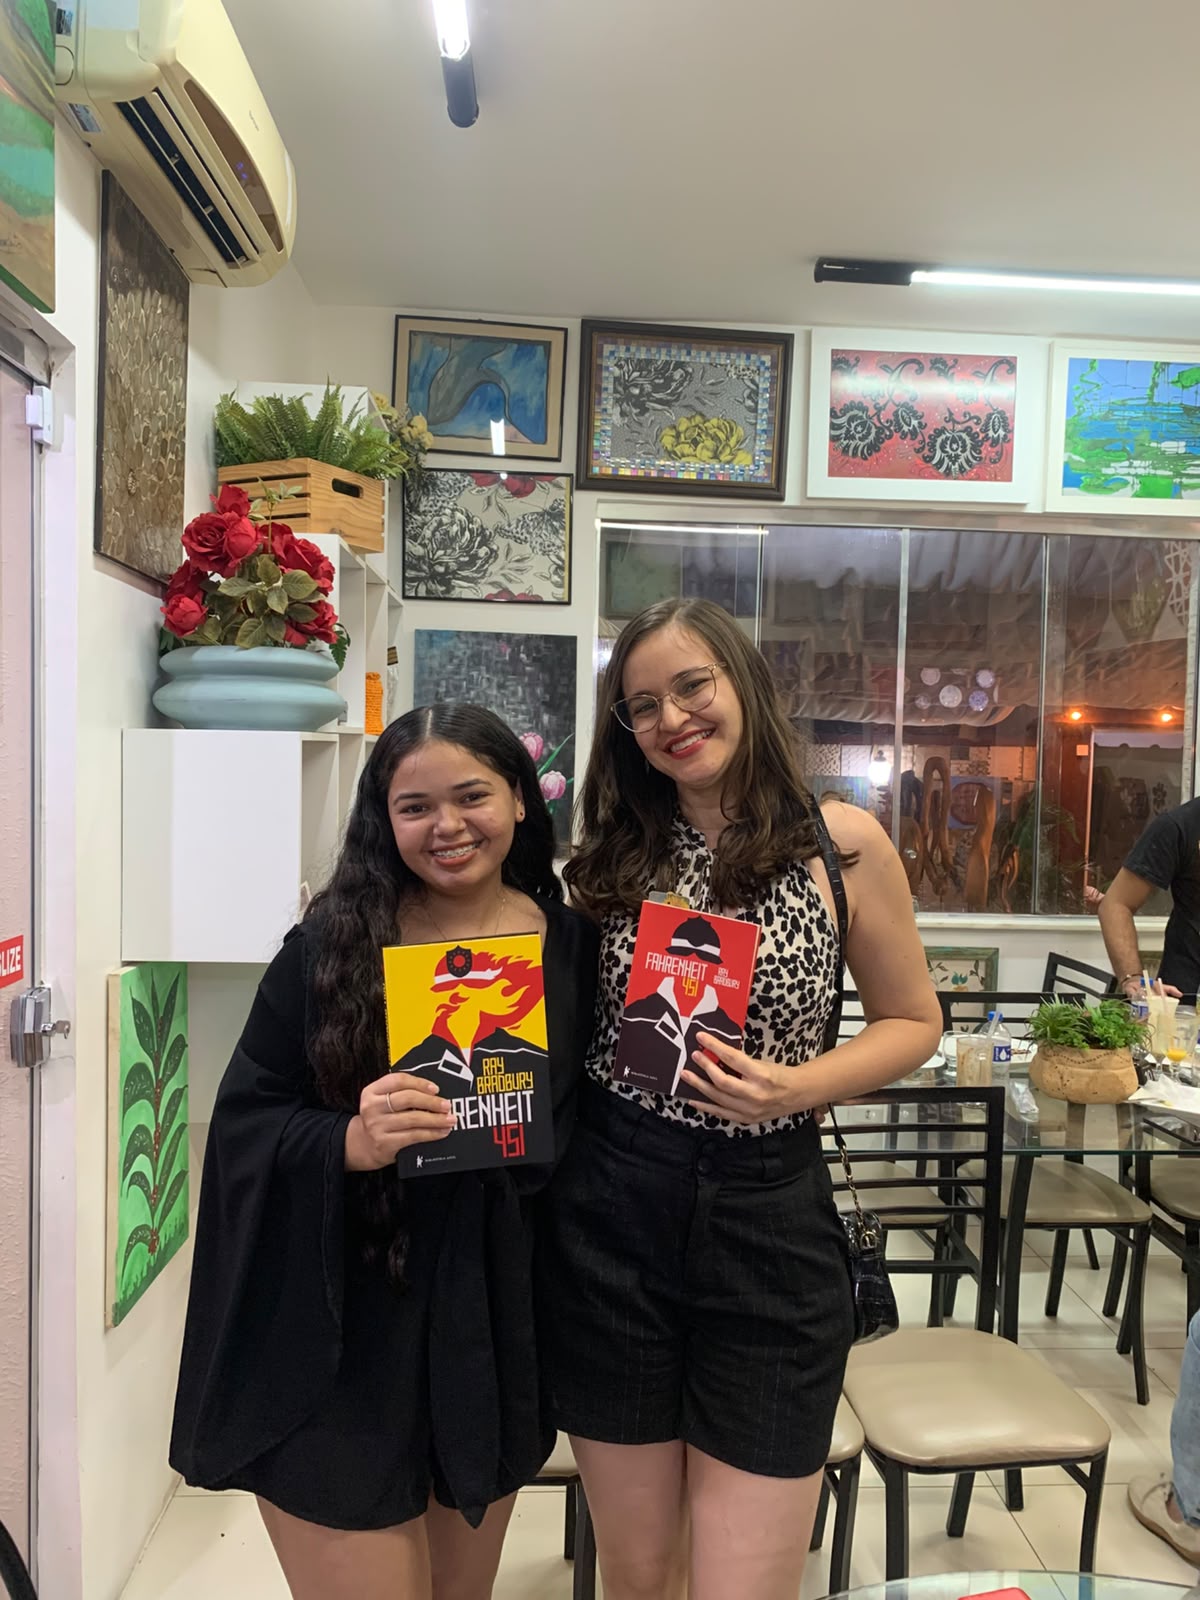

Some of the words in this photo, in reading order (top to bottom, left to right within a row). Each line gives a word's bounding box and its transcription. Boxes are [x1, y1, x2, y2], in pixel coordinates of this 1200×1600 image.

[645, 951, 708, 981] FAHRENHEIT
[682, 976, 699, 997] 451
[482, 1056, 505, 1076] RAY
[477, 1071, 534, 1095] BRADBURY
[447, 1090, 534, 1131] RENHEIT
[493, 1124, 525, 1158] 451
